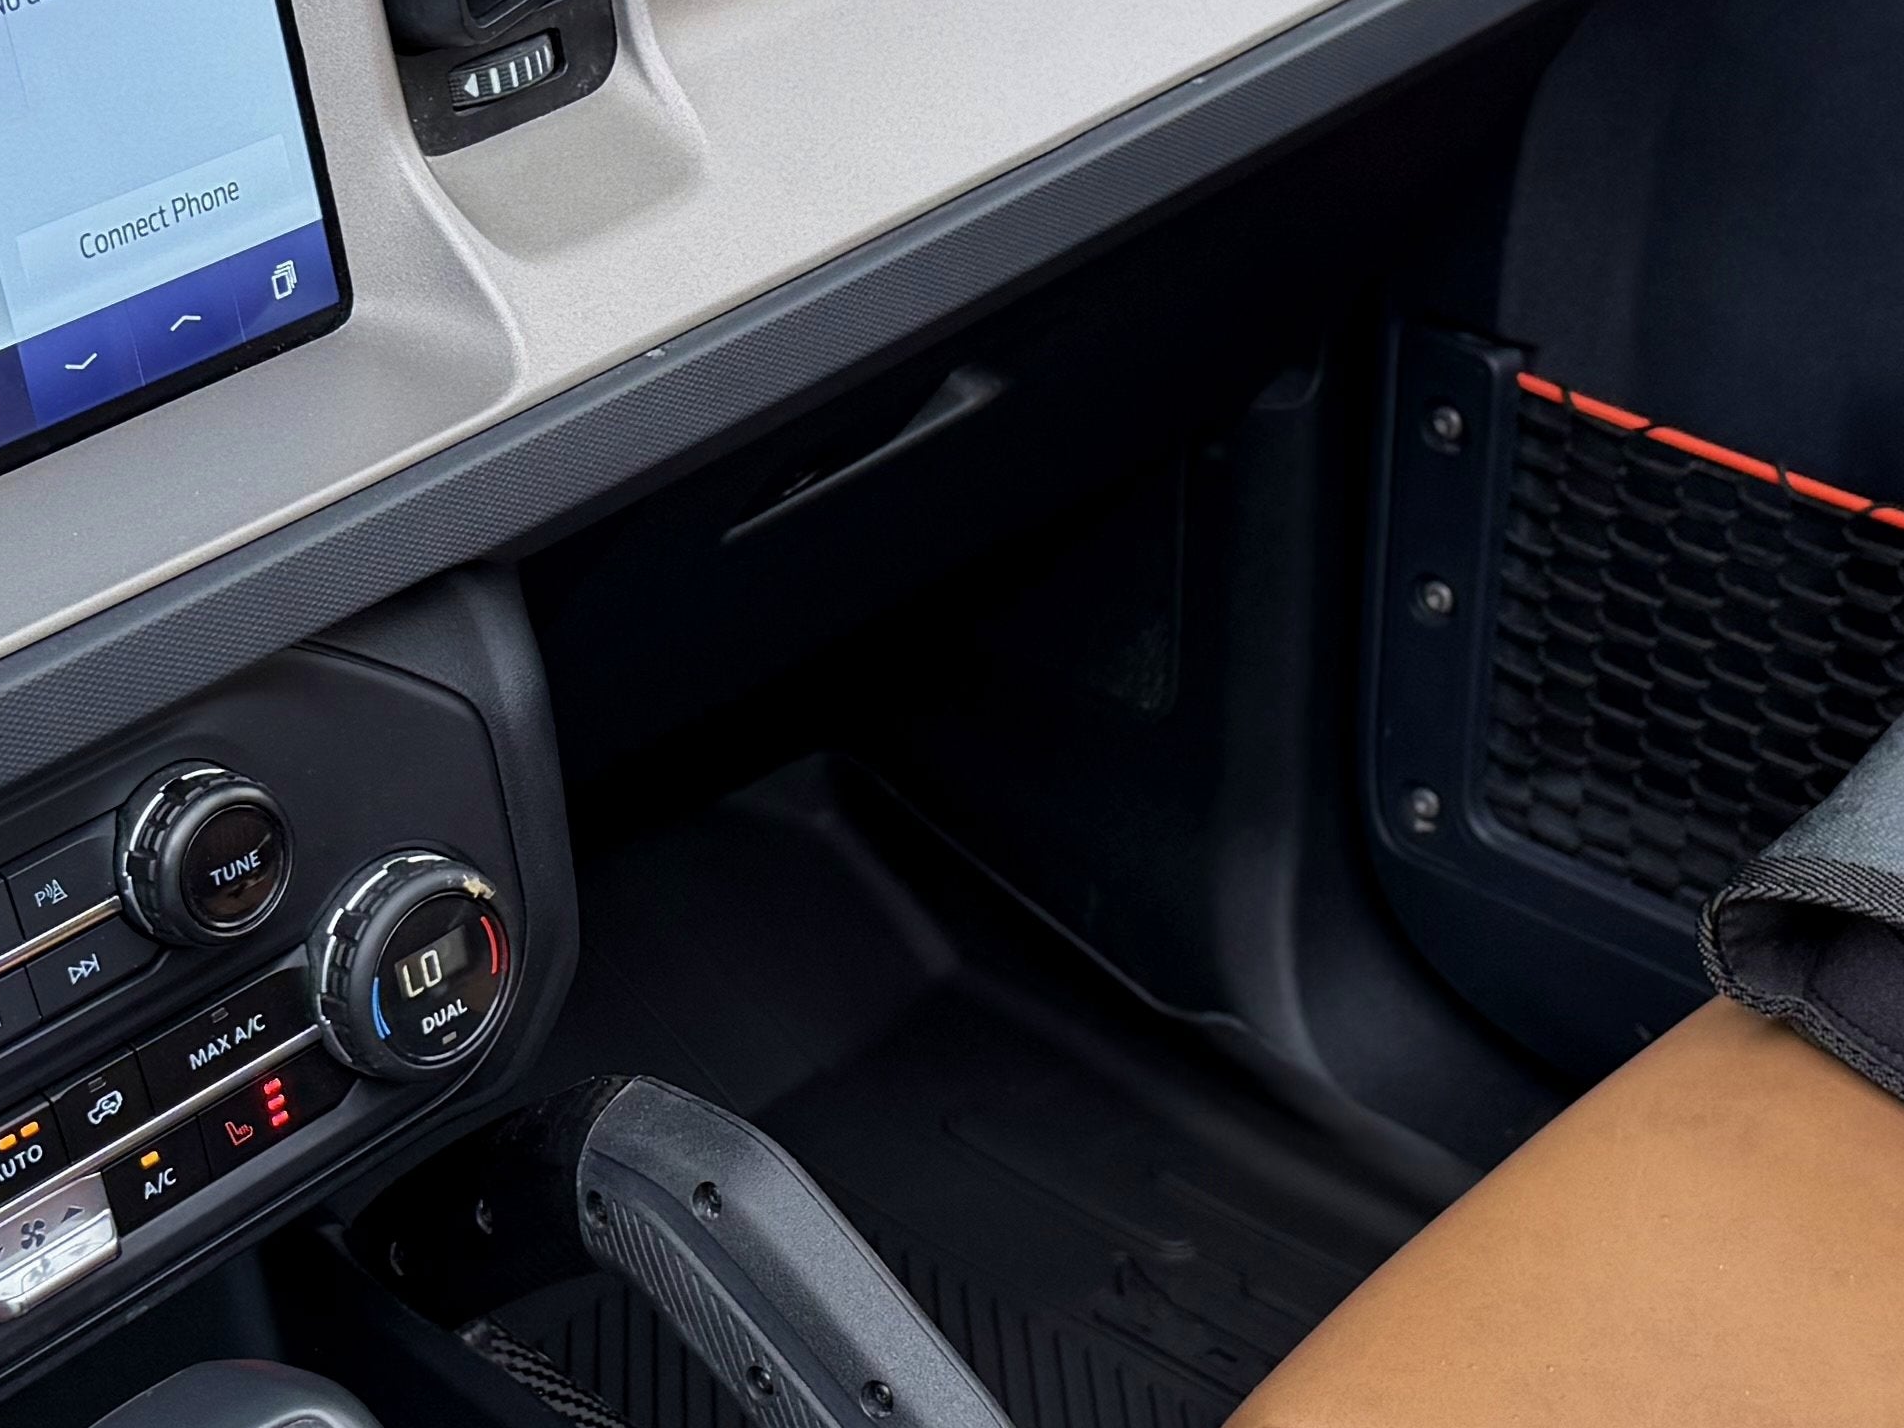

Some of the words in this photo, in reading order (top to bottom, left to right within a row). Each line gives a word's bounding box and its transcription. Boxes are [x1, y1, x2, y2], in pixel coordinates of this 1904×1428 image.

[80, 206, 168, 261] Connect
[171, 180, 240, 223] Phone
[209, 852, 262, 887] TUNE
[421, 999, 468, 1036] DUAL
[188, 1035, 231, 1071] MAX
[235, 1014, 266, 1048] A/C
[144, 1168, 177, 1201] A/C
